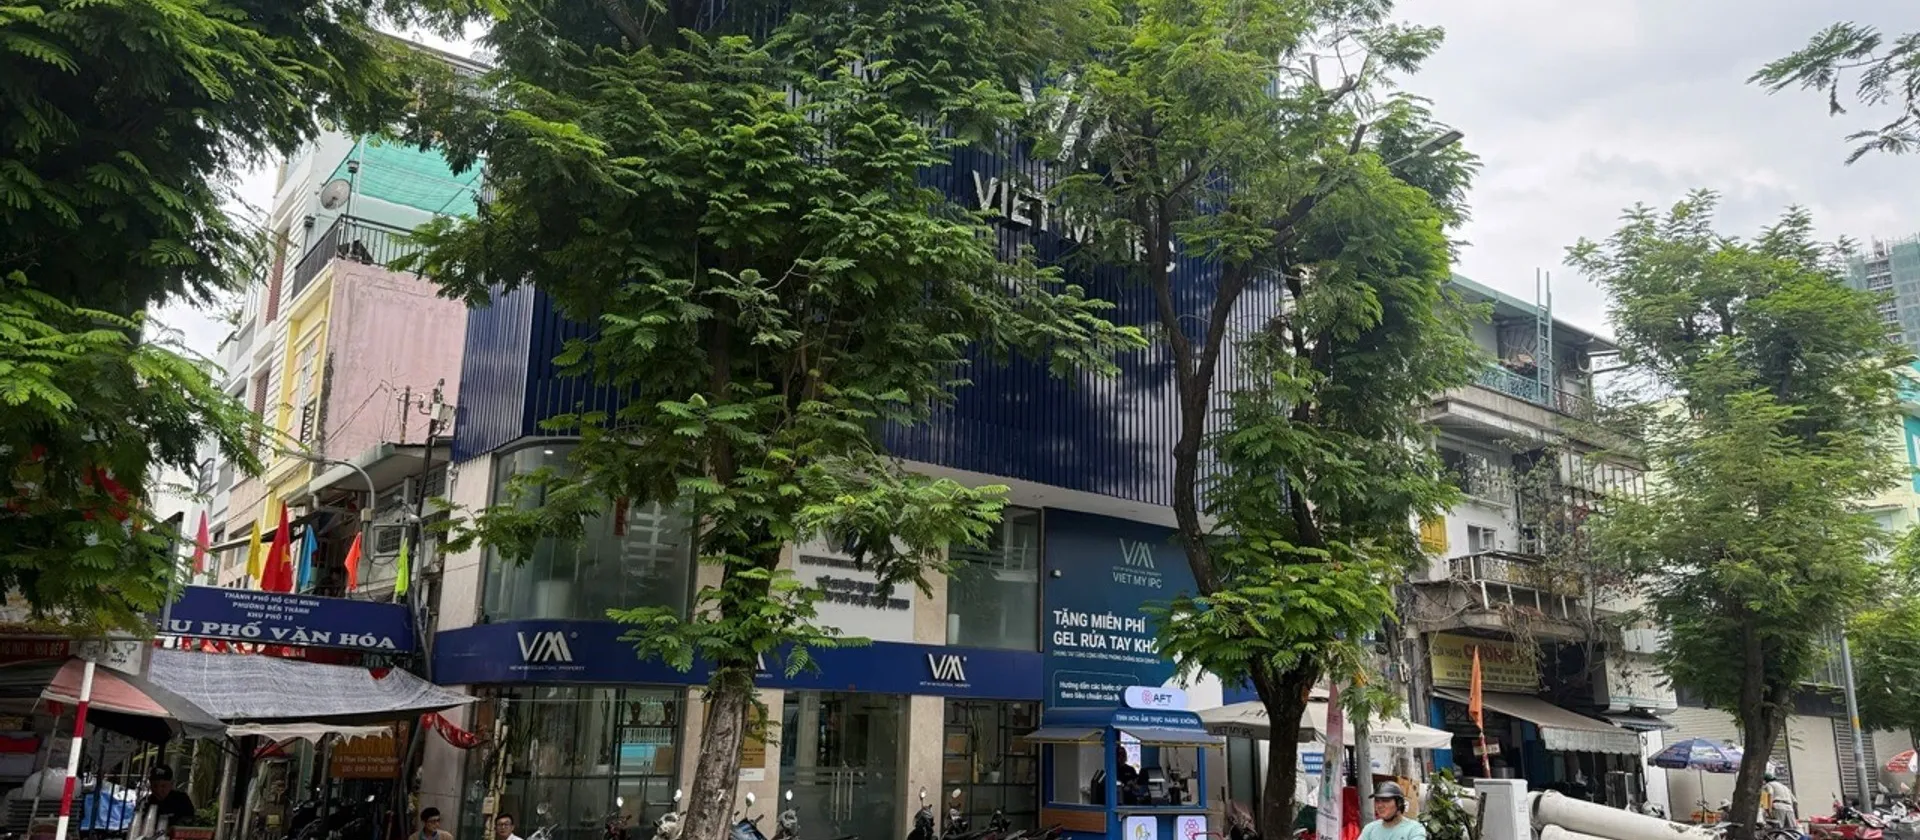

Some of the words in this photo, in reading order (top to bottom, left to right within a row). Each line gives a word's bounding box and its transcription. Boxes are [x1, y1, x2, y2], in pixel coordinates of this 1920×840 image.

[1112, 571, 1132, 584] VIET
[1053, 608, 1088, 629] TẶNG
[1124, 616, 1146, 634] PHÍ
[201, 620, 262, 638] PHỐ
[269, 625, 330, 644] VĂN
[340, 632, 397, 649] HÓA
[1053, 630, 1078, 646] GEL
[1080, 629, 1107, 649] RỬA
[1109, 635, 1132, 651] TAY
[1153, 693, 1172, 703] AFT
